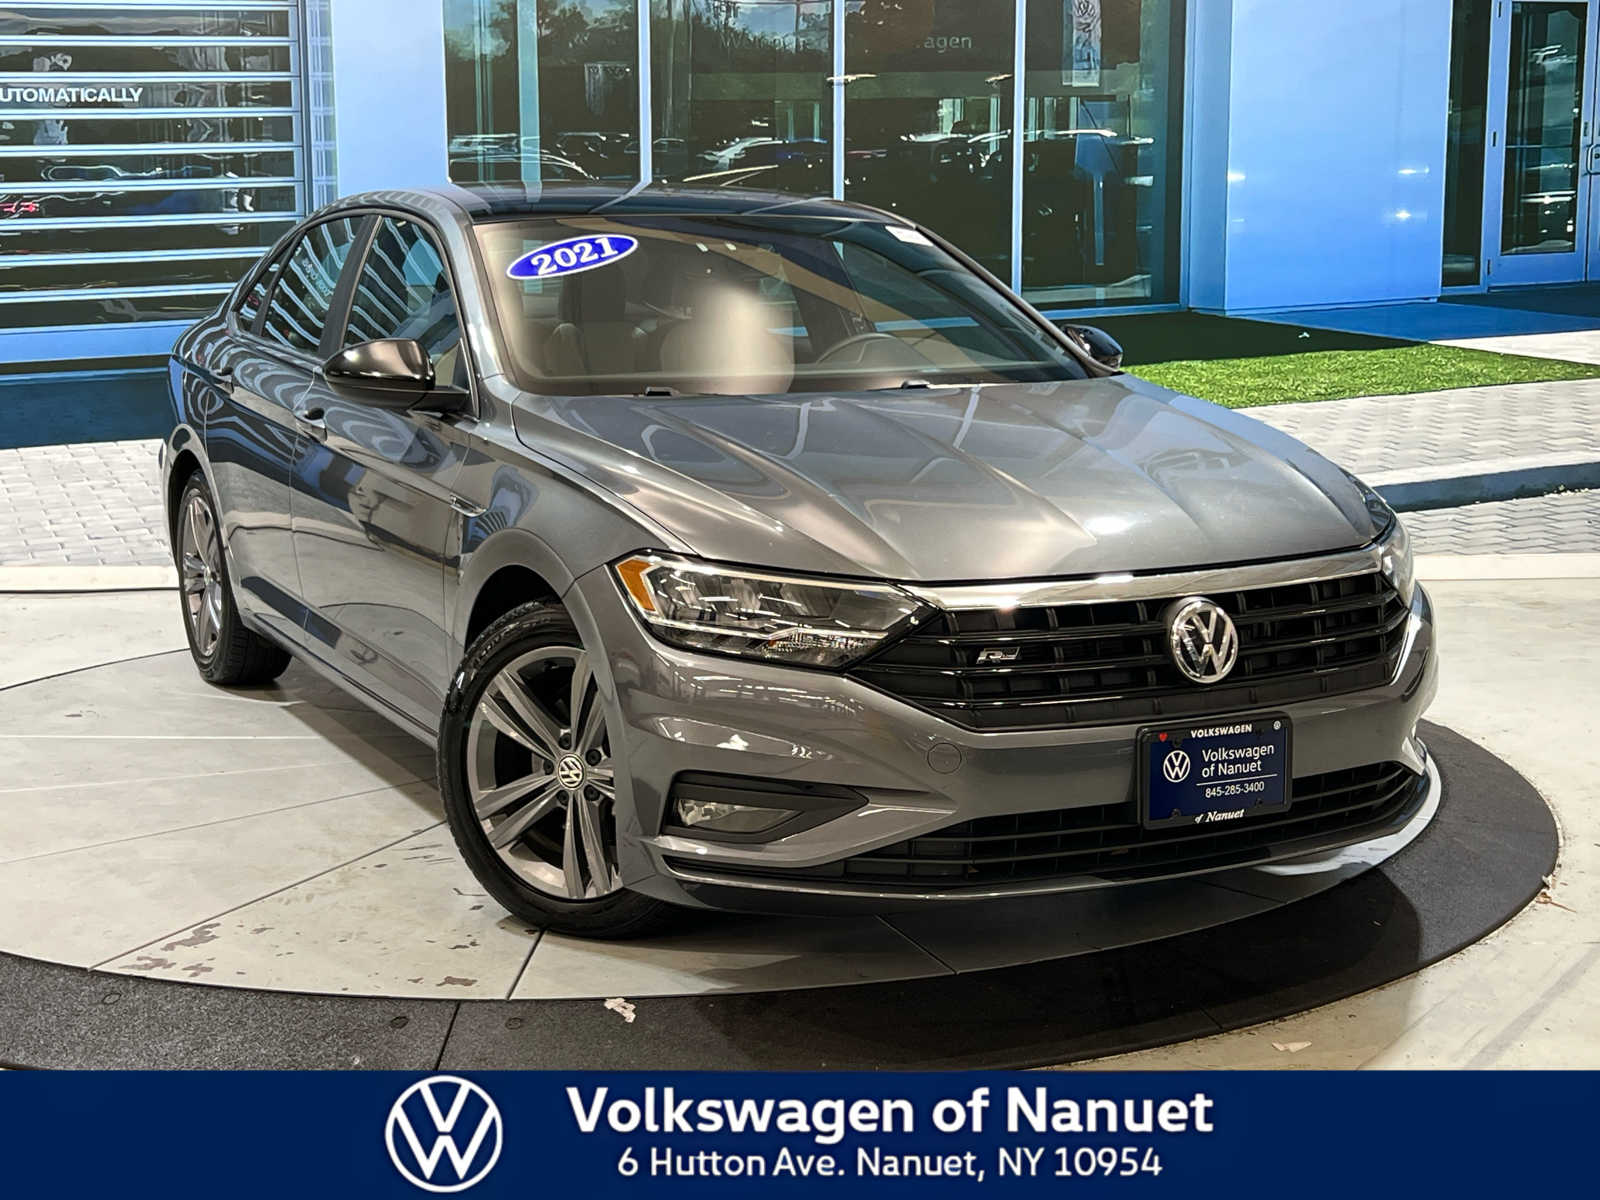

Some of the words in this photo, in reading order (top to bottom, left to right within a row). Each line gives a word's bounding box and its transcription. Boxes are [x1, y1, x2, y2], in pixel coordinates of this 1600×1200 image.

[0, 87, 143, 103] UTOMATICALLY
[530, 237, 619, 276] 2021
[1190, 723, 1253, 739] VOLKSWAGEN
[1202, 744, 1275, 763] Volkswagen
[1201, 764, 1215, 778] of
[1218, 760, 1262, 777] Nanuet
[1205, 781, 1265, 799] 845-285-3400
[1204, 809, 1245, 823] Nanuet
